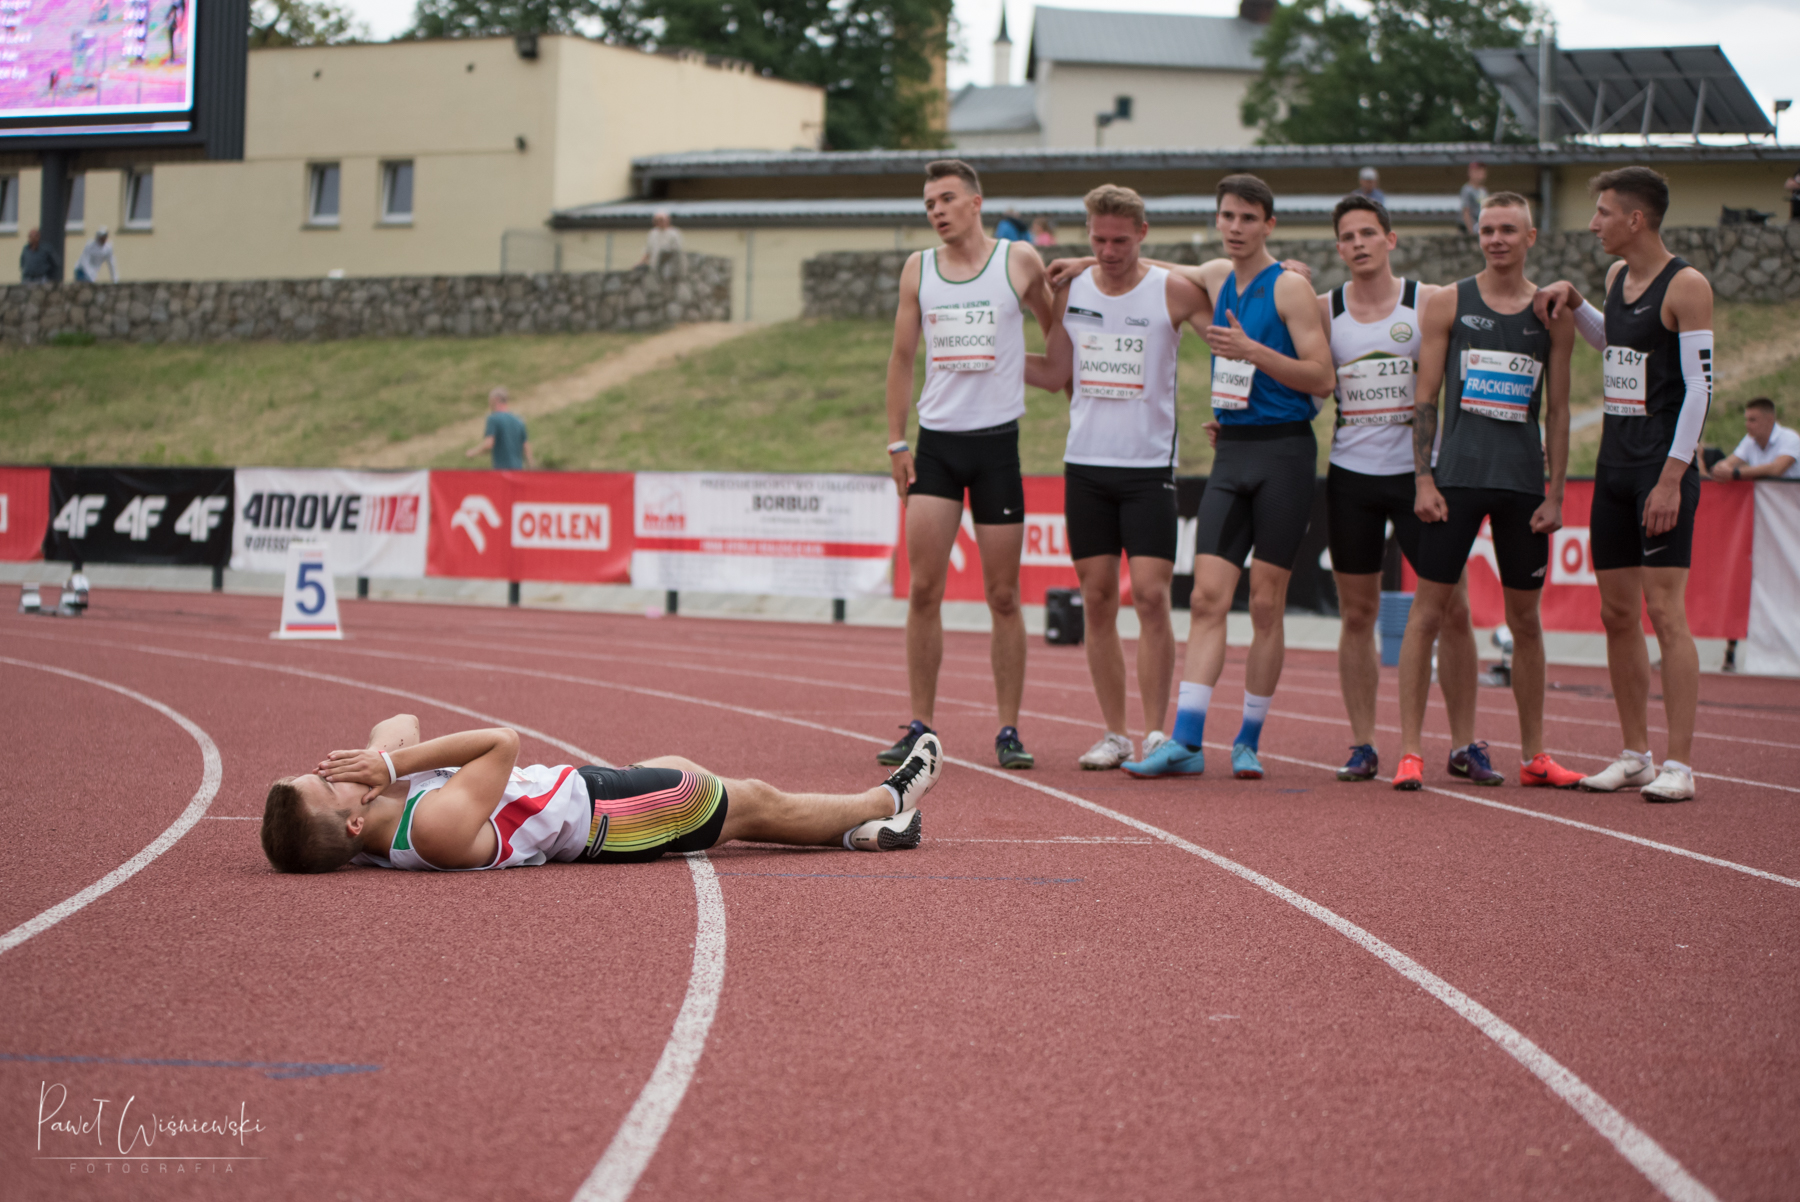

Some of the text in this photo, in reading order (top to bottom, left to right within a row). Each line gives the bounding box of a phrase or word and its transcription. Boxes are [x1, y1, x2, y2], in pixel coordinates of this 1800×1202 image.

[965, 310, 995, 325] 571
[933, 335, 995, 348] ŚWIERGOCKI
[1115, 337, 1143, 353] 193
[1508, 357, 1535, 374] 672
[1618, 350, 1643, 366] 149
[1079, 360, 1141, 375] JANOWSKI
[1377, 360, 1409, 376] 212
[1346, 386, 1408, 402] WŁOSTEK
[1466, 378, 1533, 398] FRĄCKIEWICZ
[1469, 406, 1509, 418] RACIBÓRZ
[243, 492, 361, 532] 4MOVE
[752, 496, 820, 513] BORBUD
[53, 494, 227, 542] 4F 4F 4F
[519, 512, 601, 540] ORLEN
[296, 563, 326, 616] 5
